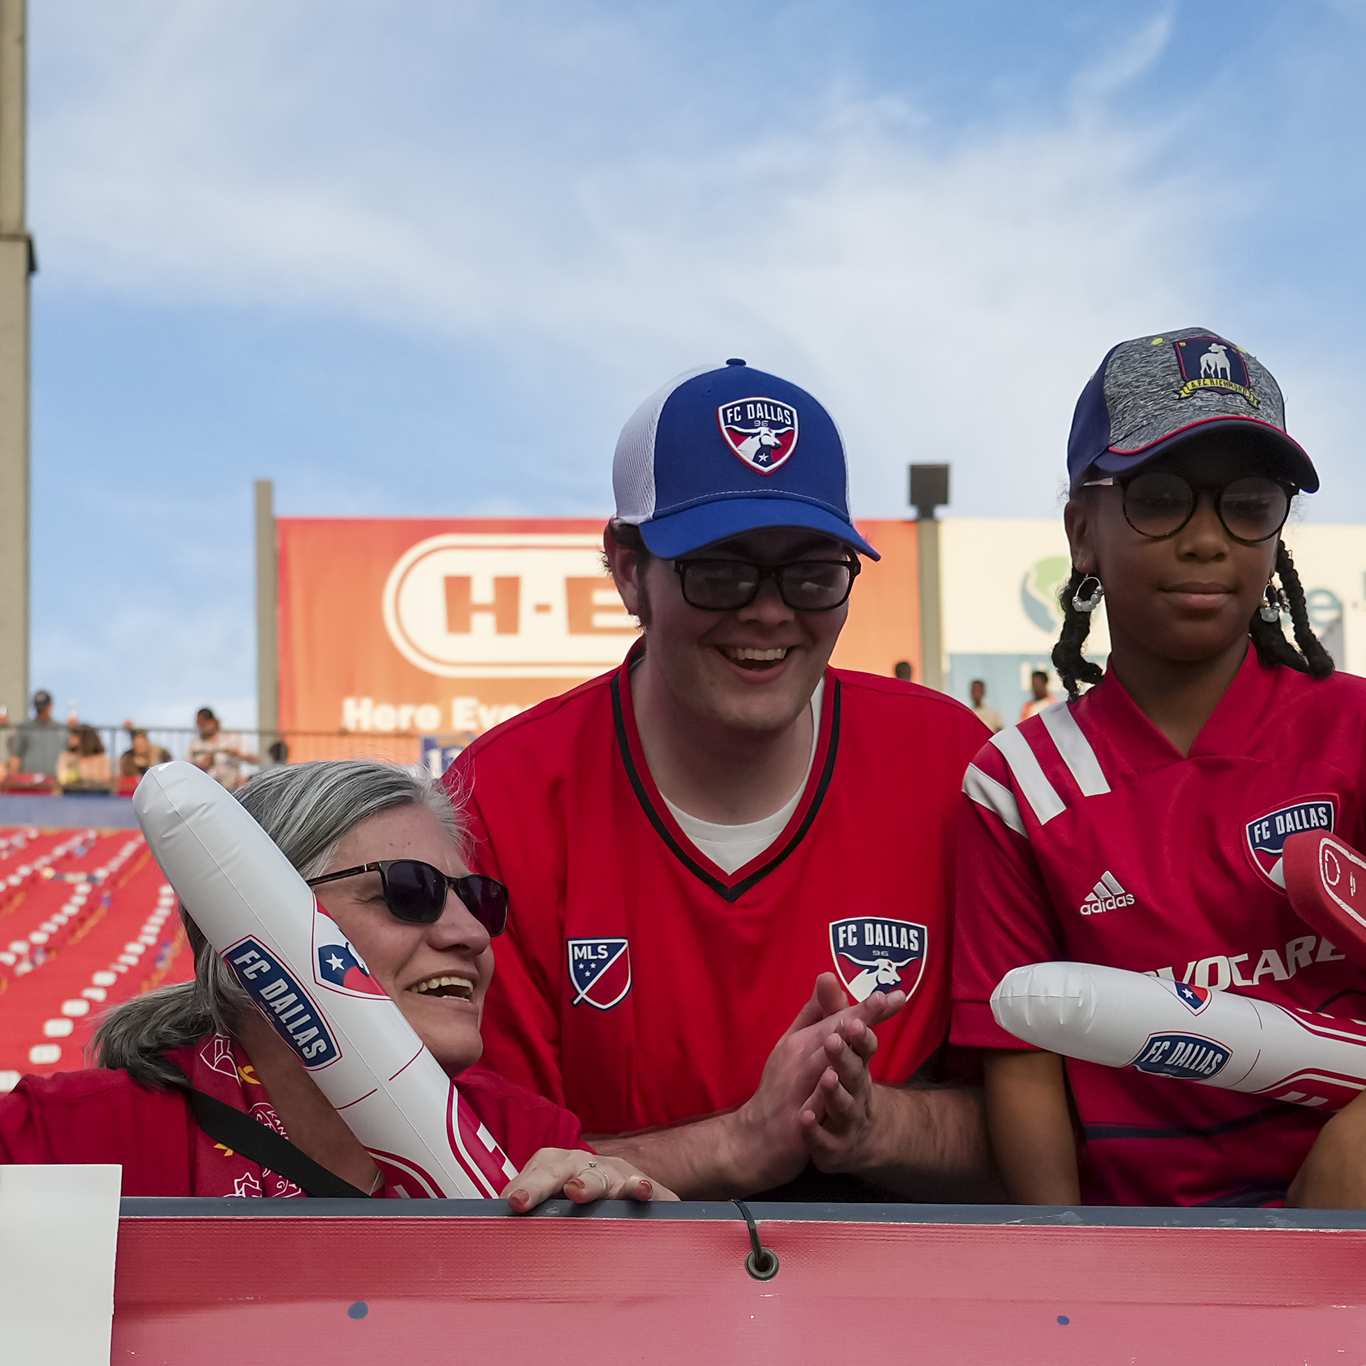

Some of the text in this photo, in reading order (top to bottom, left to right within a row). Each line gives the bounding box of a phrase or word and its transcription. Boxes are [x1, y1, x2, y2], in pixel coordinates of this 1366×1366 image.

[726, 402, 792, 425] FC DALLAS
[342, 696, 442, 732] Here
[1253, 806, 1329, 844] FC DALLAS
[1079, 893, 1135, 916] adidas
[573, 944, 609, 961] MLS
[838, 922, 919, 952] FC DALLAS
[233, 949, 328, 1060] FC DALLAS
[1139, 1041, 1224, 1075] FC DALLAS
